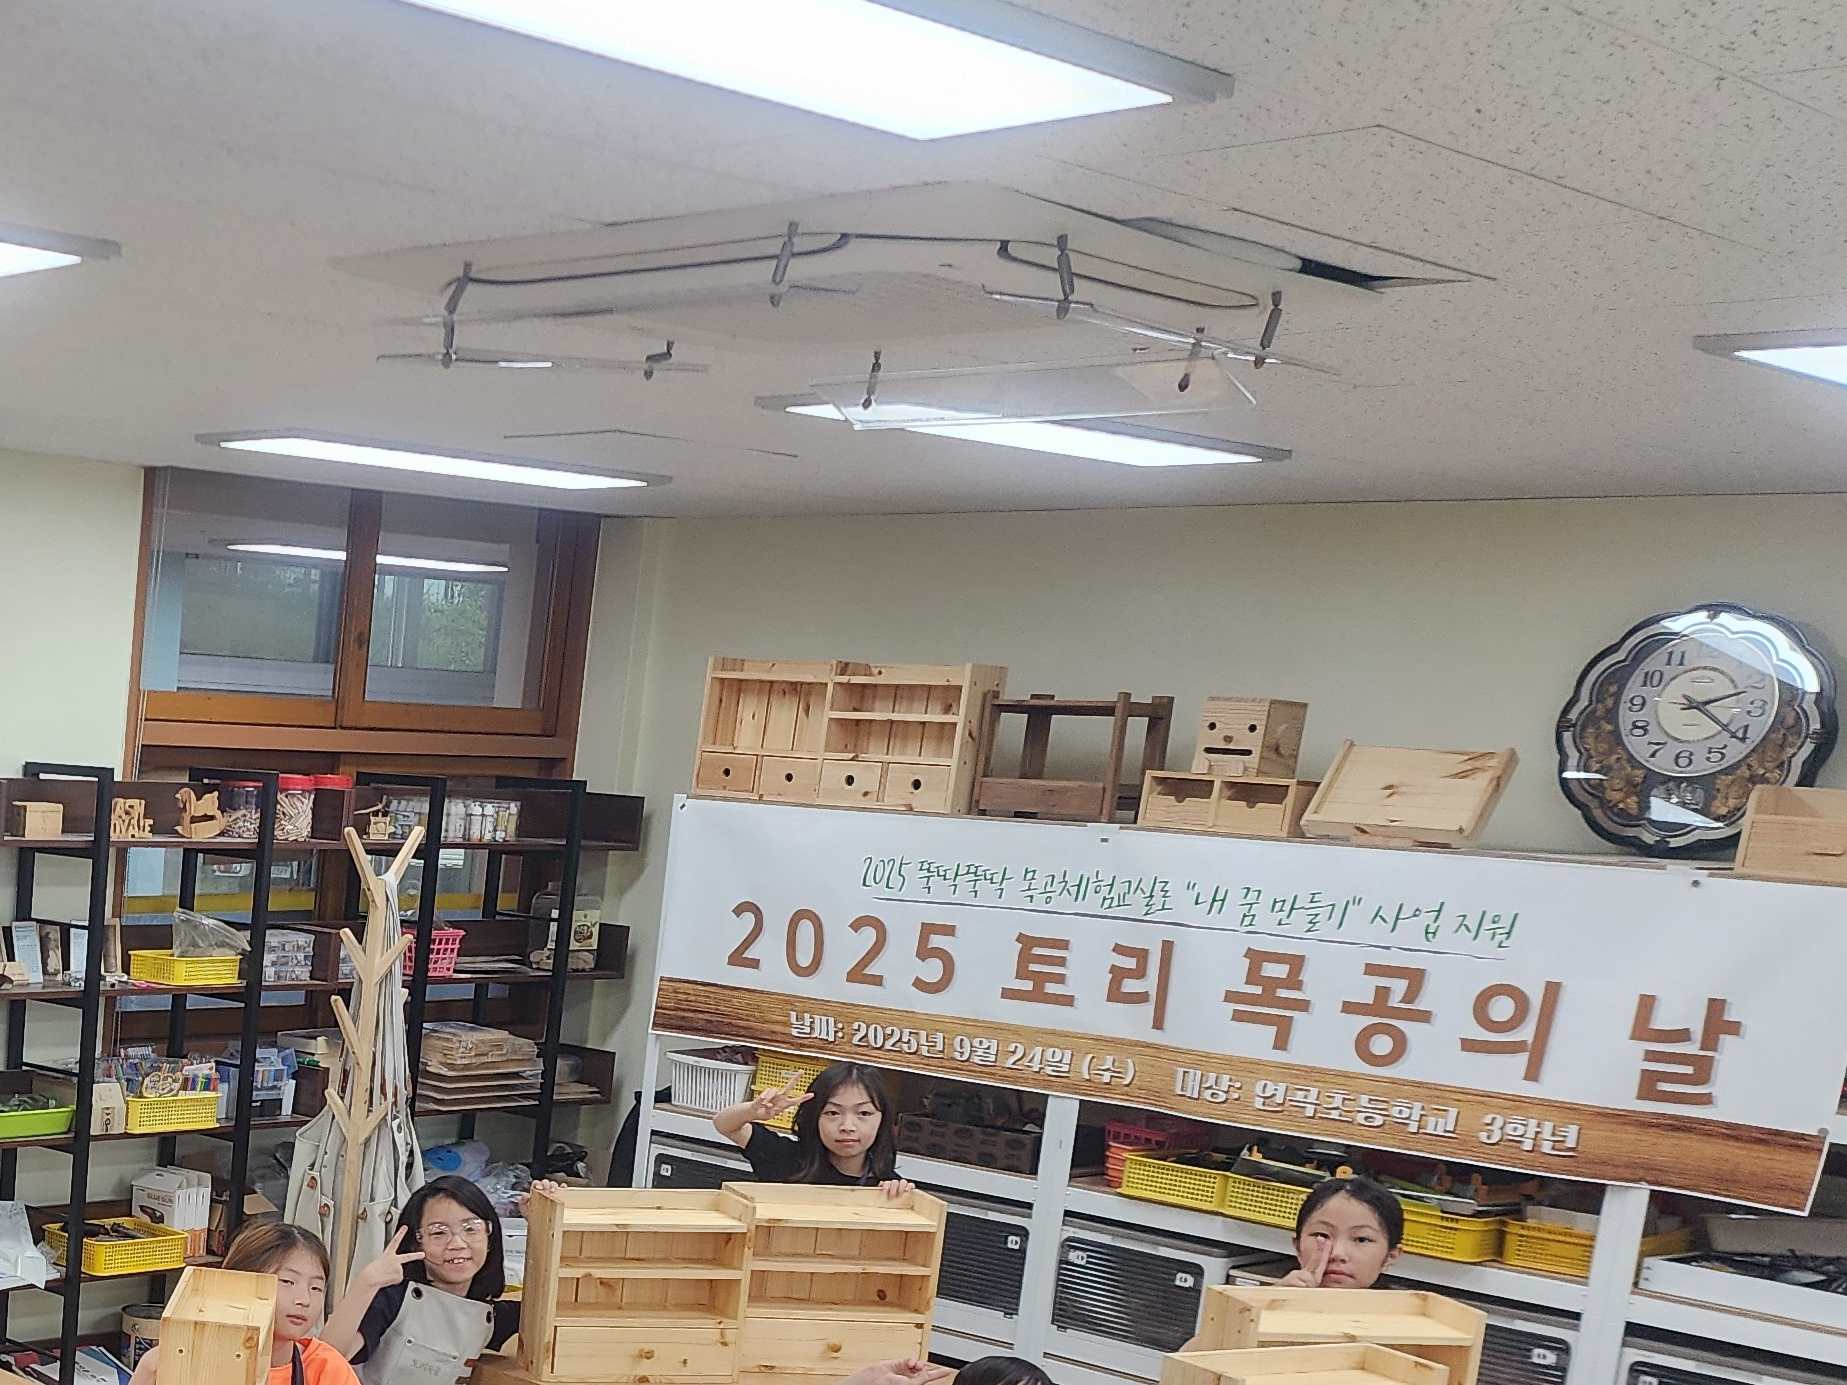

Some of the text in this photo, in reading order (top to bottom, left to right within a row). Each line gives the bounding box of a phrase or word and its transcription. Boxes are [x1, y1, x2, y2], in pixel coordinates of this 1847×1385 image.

[1665, 650, 1687, 666] 11
[1641, 669, 1663, 688] 10
[1628, 695, 1647, 713] 9
[1747, 699, 1767, 718] 3
[1629, 719, 1650, 738] 8
[1647, 740, 1668, 759] 7
[1674, 749, 1694, 768] 6
[1706, 744, 1728, 764] 5
[861, 855, 911, 893] 2025
[917, 859, 1013, 899] 뚝딱뚝딱
[1237, 886, 1263, 928] 꿈
[1370, 901, 1445, 943] 사업
[1453, 909, 1520, 949] 지원
[726, 900, 1744, 1107] 2025 토리 목공의 날
[851, 1020, 946, 1059] 2025년
[953, 1034, 999, 1066] 9월
[1004, 1042, 1075, 1078] 24일
[1080, 1052, 1137, 1086] (수)
[1174, 1067, 1243, 1103] 대상:
[1253, 1078, 1461, 1140] 연곡초등학교
[1477, 1112, 1583, 1157] 3학년
